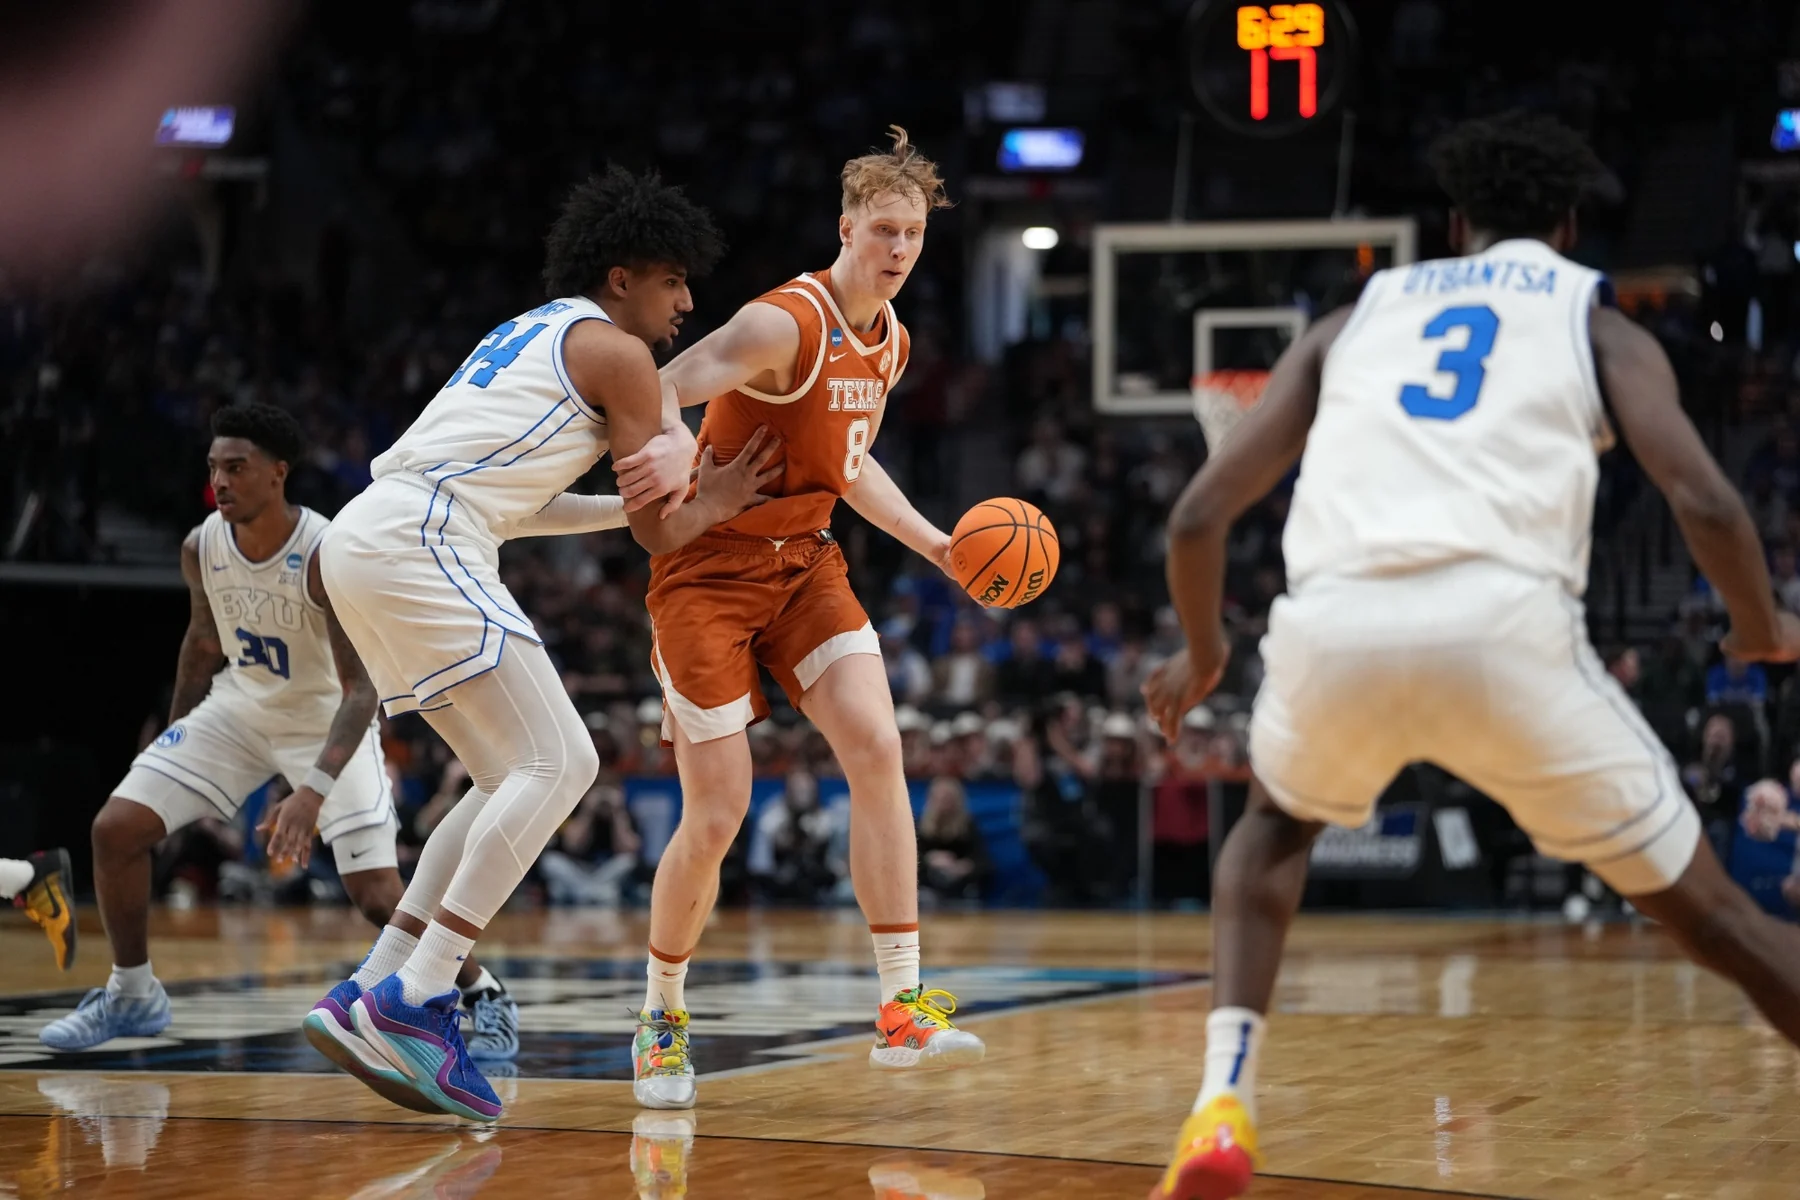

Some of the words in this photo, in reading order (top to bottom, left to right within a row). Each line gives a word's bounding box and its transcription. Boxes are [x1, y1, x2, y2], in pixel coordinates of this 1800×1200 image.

[1250, 46, 1317, 120] 17
[1399, 305, 1500, 422] 3
[826, 377, 885, 412] TEXAS
[843, 416, 870, 484] 8
[216, 586, 304, 633] BYU
[235, 626, 290, 680] 30
